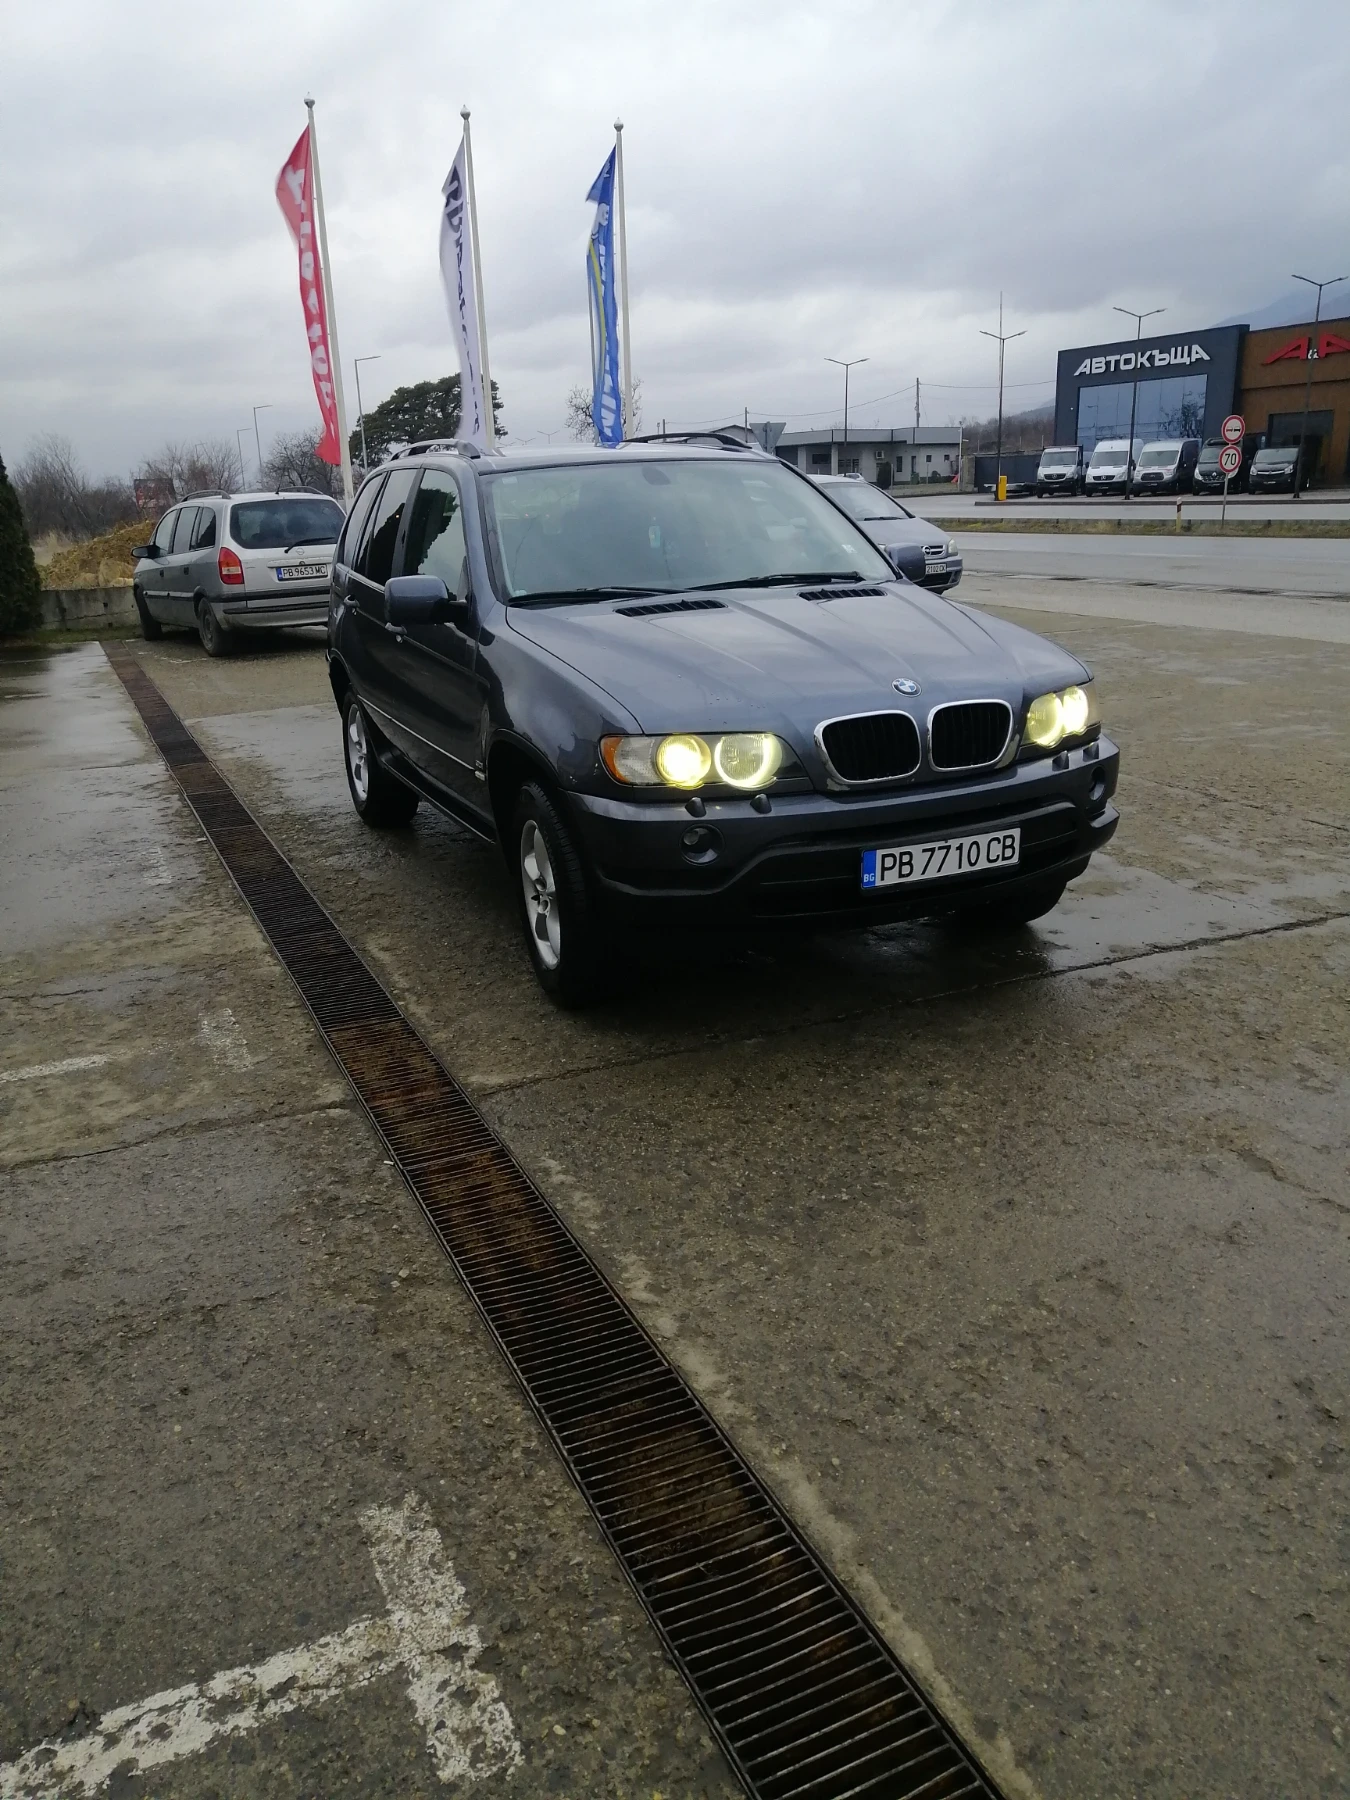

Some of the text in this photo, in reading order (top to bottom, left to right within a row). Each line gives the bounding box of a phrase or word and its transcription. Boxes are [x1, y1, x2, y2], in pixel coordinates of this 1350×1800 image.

[1074, 344, 1211, 377] АВТОКЪЩА
[1224, 453, 1237, 466] 70
[283, 568, 294, 577] PB
[295, 567, 314, 576] 9653
[881, 834, 1016, 881] PB 7710 CB
[863, 873, 875, 883] BG
